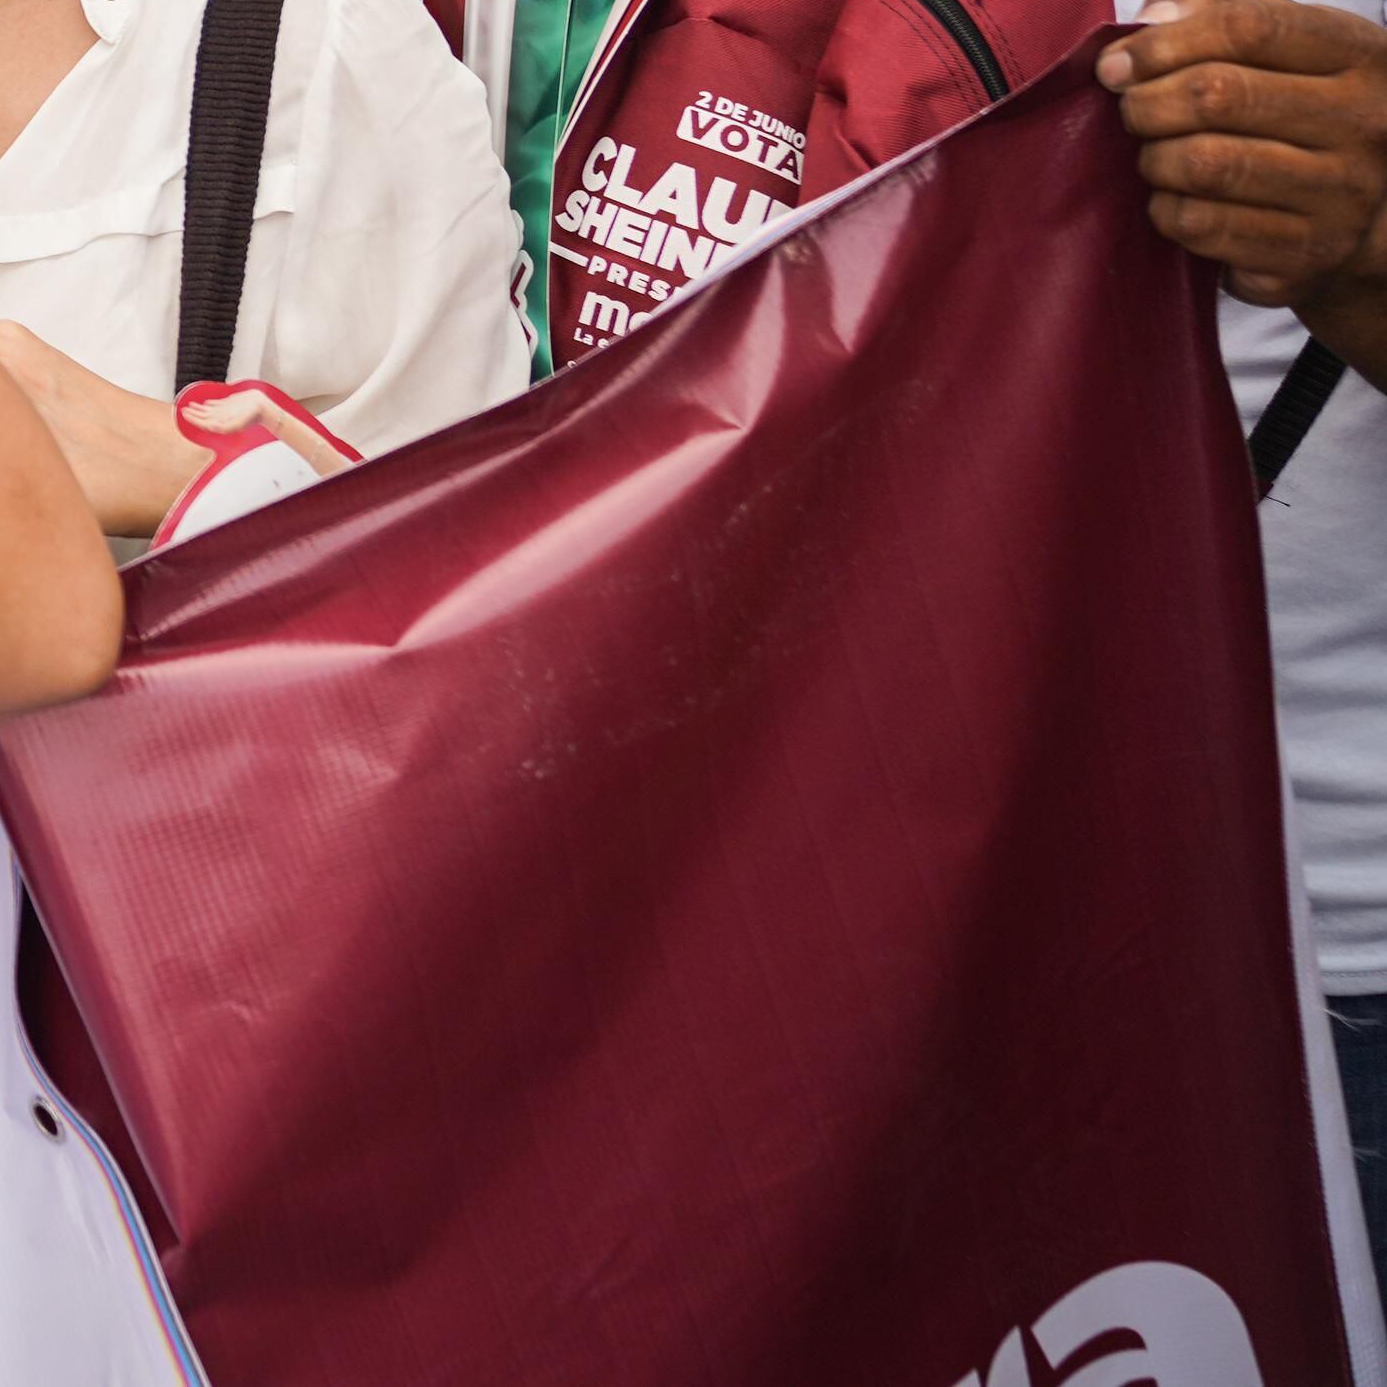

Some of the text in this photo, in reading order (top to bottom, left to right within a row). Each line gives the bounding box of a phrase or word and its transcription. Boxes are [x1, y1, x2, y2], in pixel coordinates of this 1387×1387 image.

[683, 112, 804, 182] VOTA
[696, 90, 806, 149] 2 DE JUNIO
[555, 190, 739, 280] SHEIN
